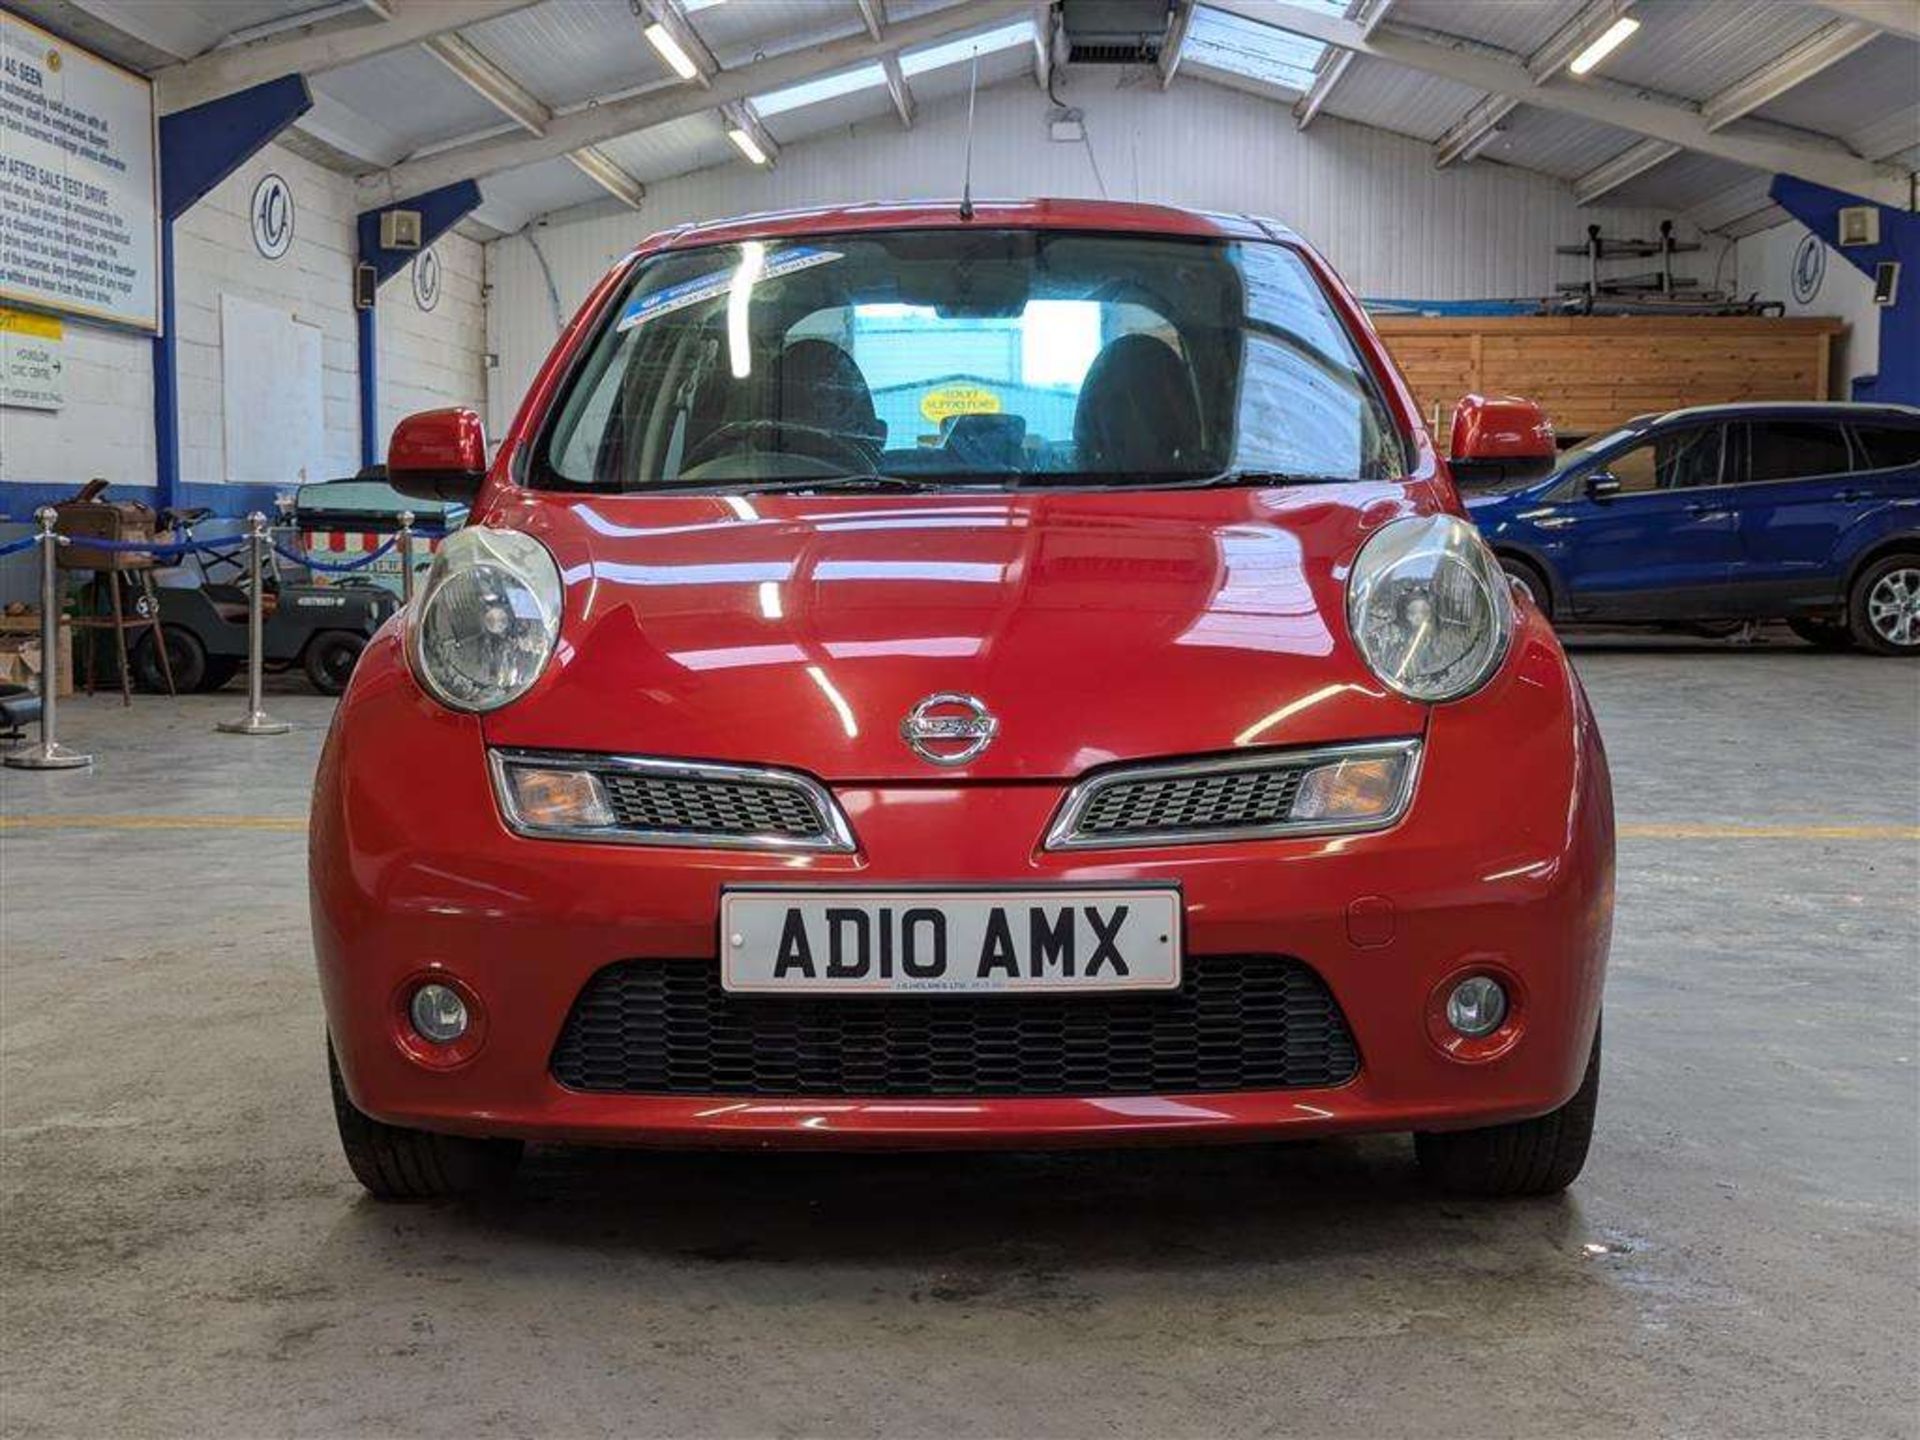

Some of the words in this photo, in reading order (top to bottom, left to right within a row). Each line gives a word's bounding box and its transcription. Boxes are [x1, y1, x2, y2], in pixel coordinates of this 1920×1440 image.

[20, 62, 43, 89] SEEN
[8, 158, 36, 181] AFTER
[39, 167, 61, 191] SALE
[62, 175, 82, 198] TEST
[84, 183, 108, 207] DRIVE
[773, 908, 947, 977] AD10
[976, 906, 1129, 977] AMX
